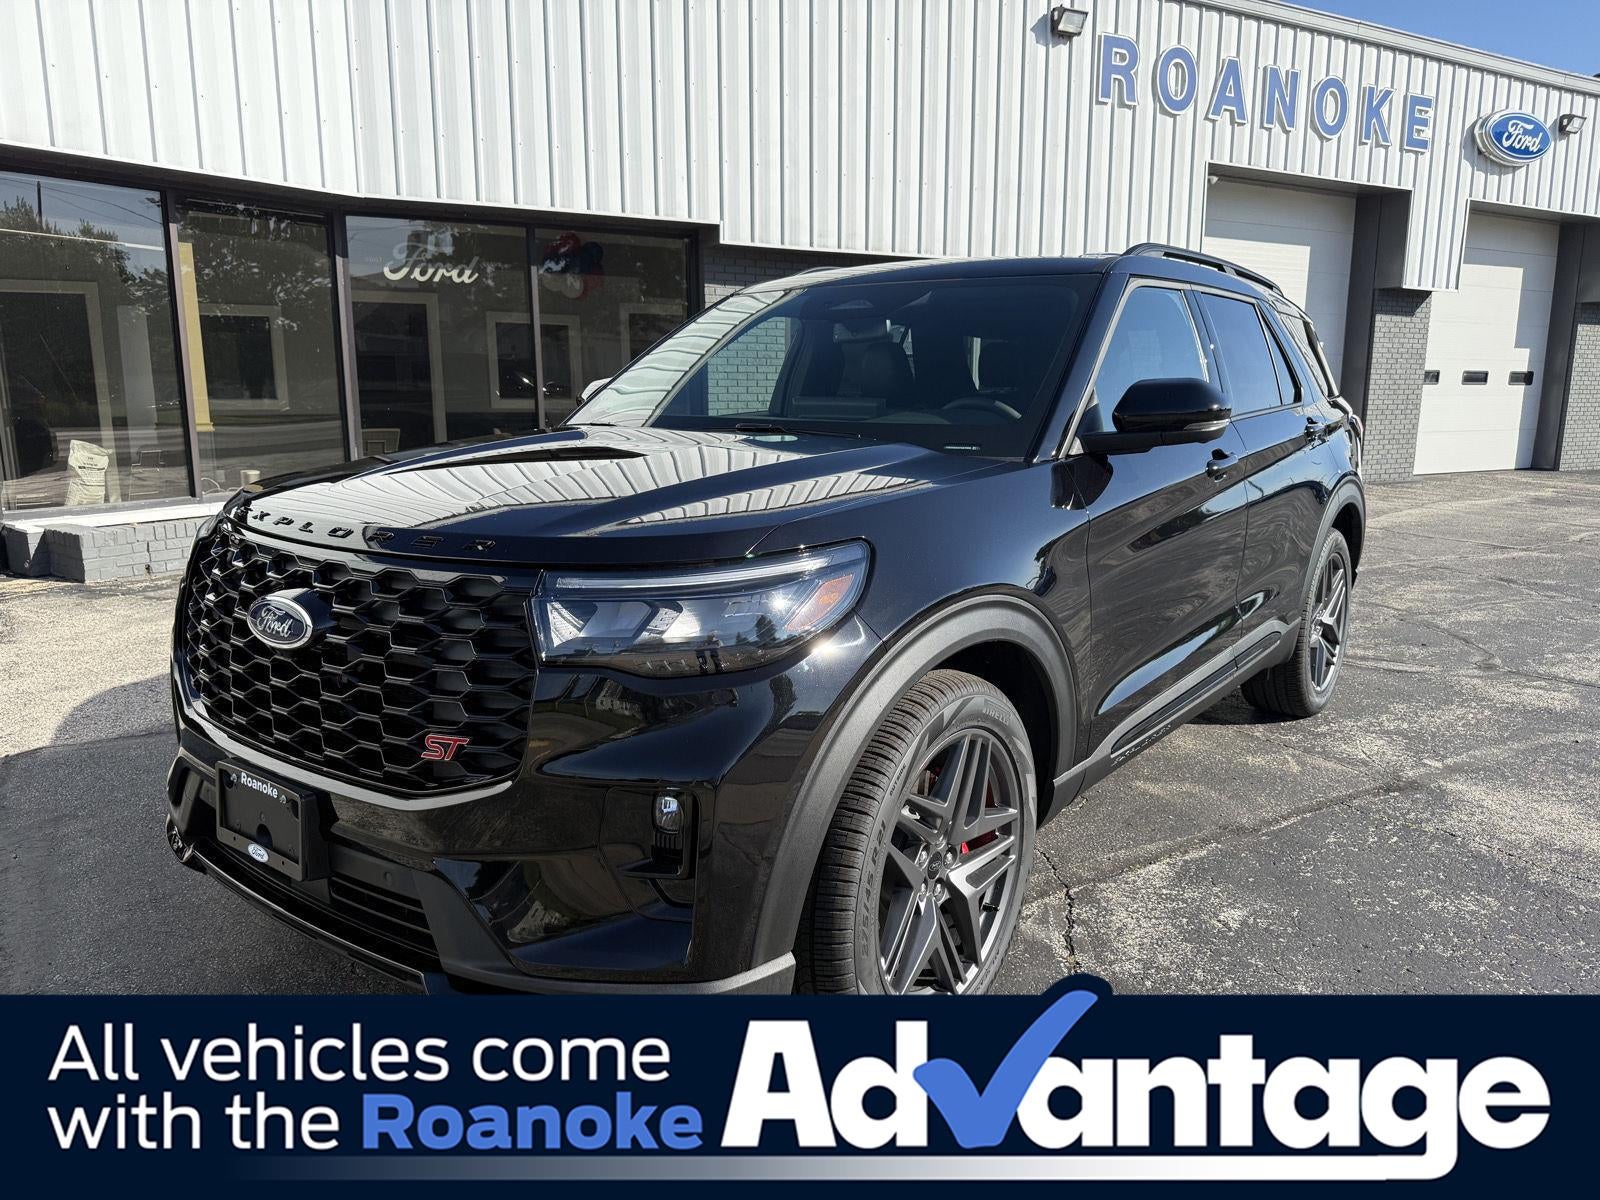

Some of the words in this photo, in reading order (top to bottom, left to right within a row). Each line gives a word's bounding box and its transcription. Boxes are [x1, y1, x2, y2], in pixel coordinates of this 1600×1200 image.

[1098, 33, 1435, 153] ROANOKE
[1502, 119, 1543, 153] Ford
[384, 241, 480, 283] Ford
[257, 604, 293, 638] Ford
[421, 734, 469, 760] ST
[240, 771, 279, 799] Roanoke
